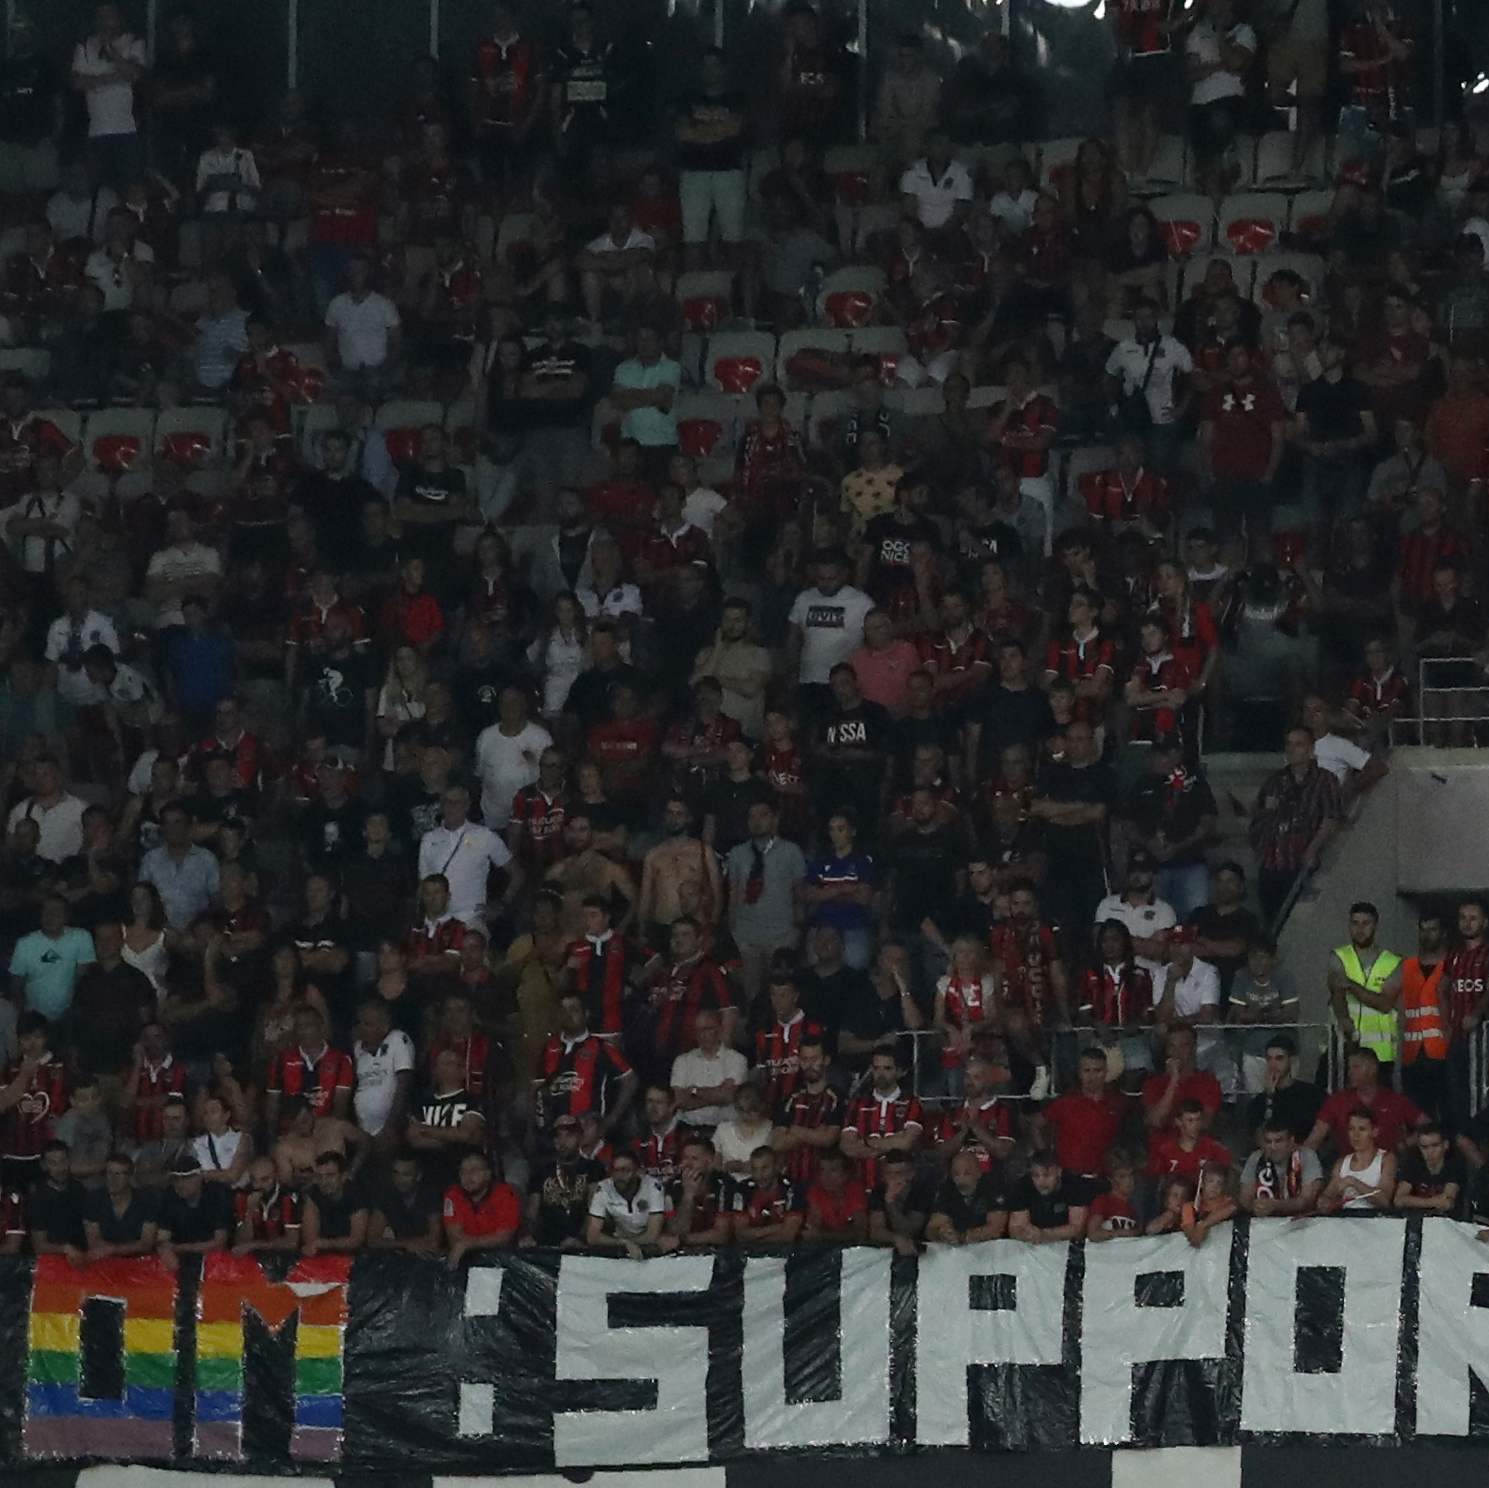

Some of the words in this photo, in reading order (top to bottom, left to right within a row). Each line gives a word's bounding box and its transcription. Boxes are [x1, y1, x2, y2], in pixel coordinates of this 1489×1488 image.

[826, 722, 866, 745] NSSA
[1456, 978, 1483, 993] EOS
[20, 1250, 354, 1462] OM
